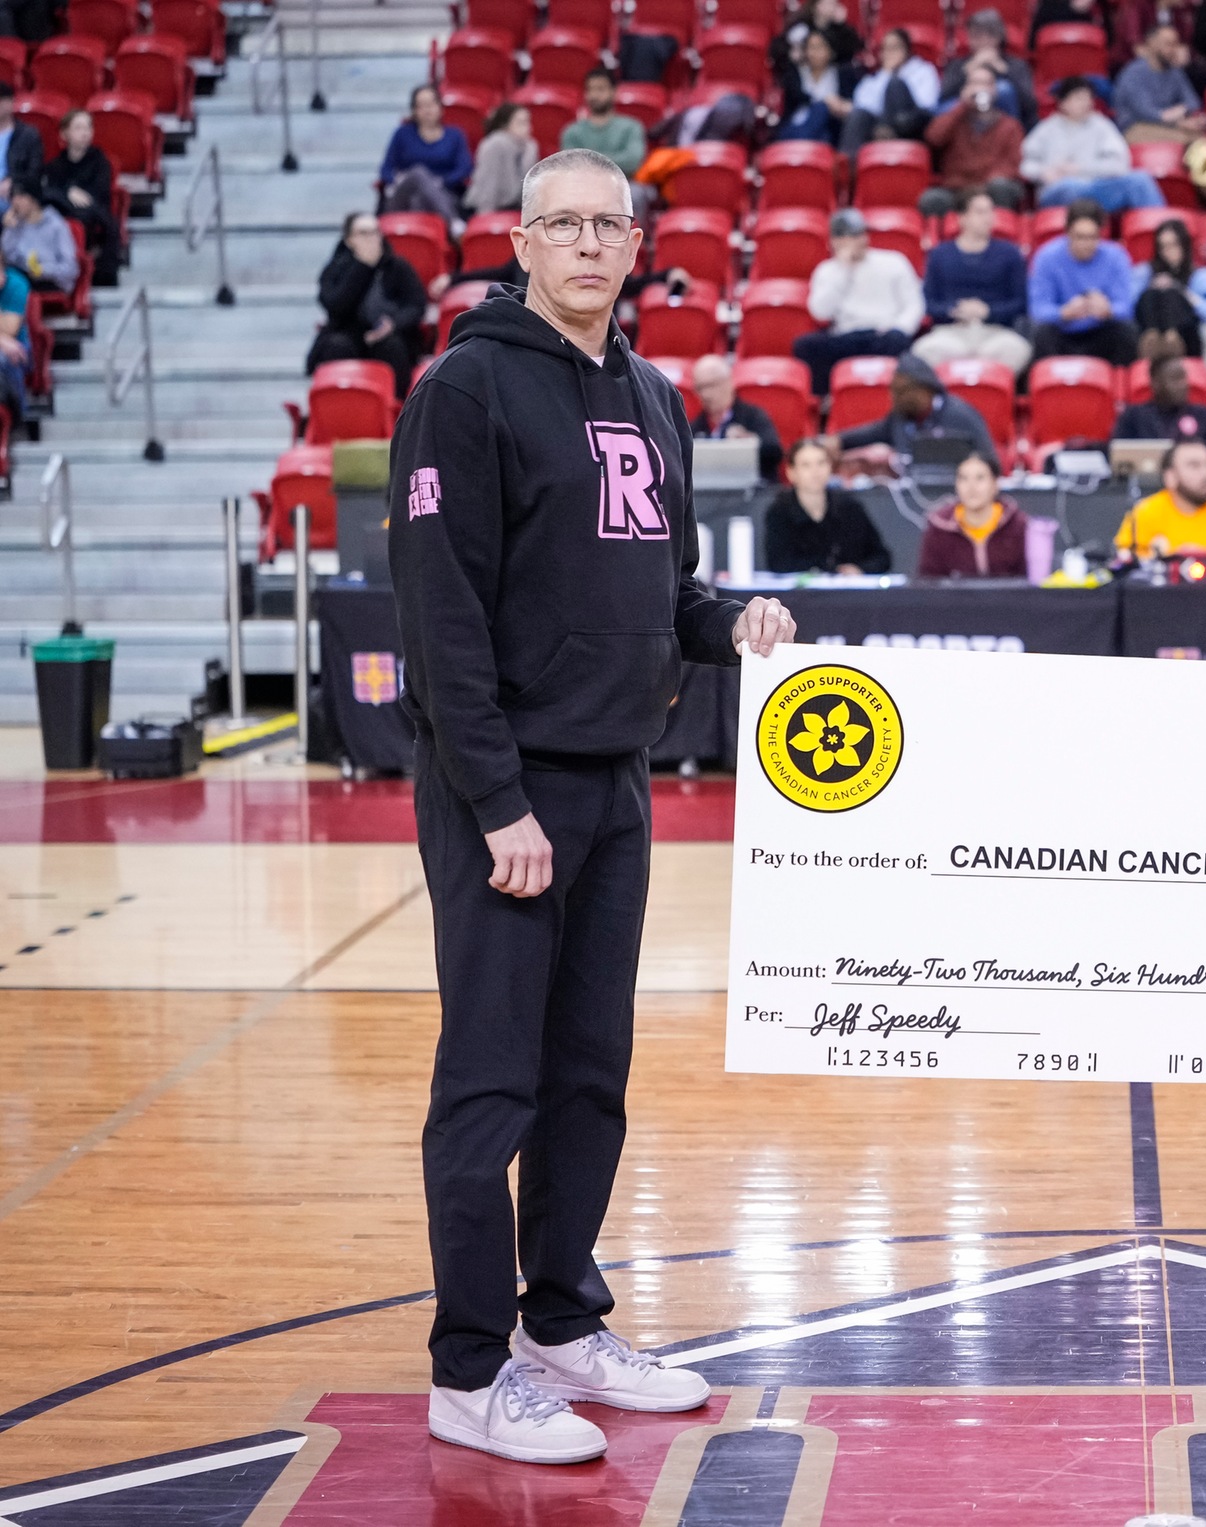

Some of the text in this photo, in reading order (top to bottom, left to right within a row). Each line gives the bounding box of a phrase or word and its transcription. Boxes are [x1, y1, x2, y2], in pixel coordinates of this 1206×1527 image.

[585, 421, 670, 540] R
[778, 676, 883, 713] PROUD SUPPORTER
[768, 723, 892, 801] THE CANADIAN CANCER SOCIETY
[752, 849, 784, 868] Pay
[791, 853, 807, 865] to
[815, 851, 842, 866] the
[849, 853, 899, 868] order
[906, 854, 927, 869] of:
[951, 845, 1107, 872] CANADIAN
[746, 961, 825, 977] Amount:
[835, 957, 967, 985] Ninety-Two
[972, 959, 1081, 988] Thousand,
[1091, 963, 1131, 986] Six
[746, 1003, 962, 1038] Per: Jeff Speedy
